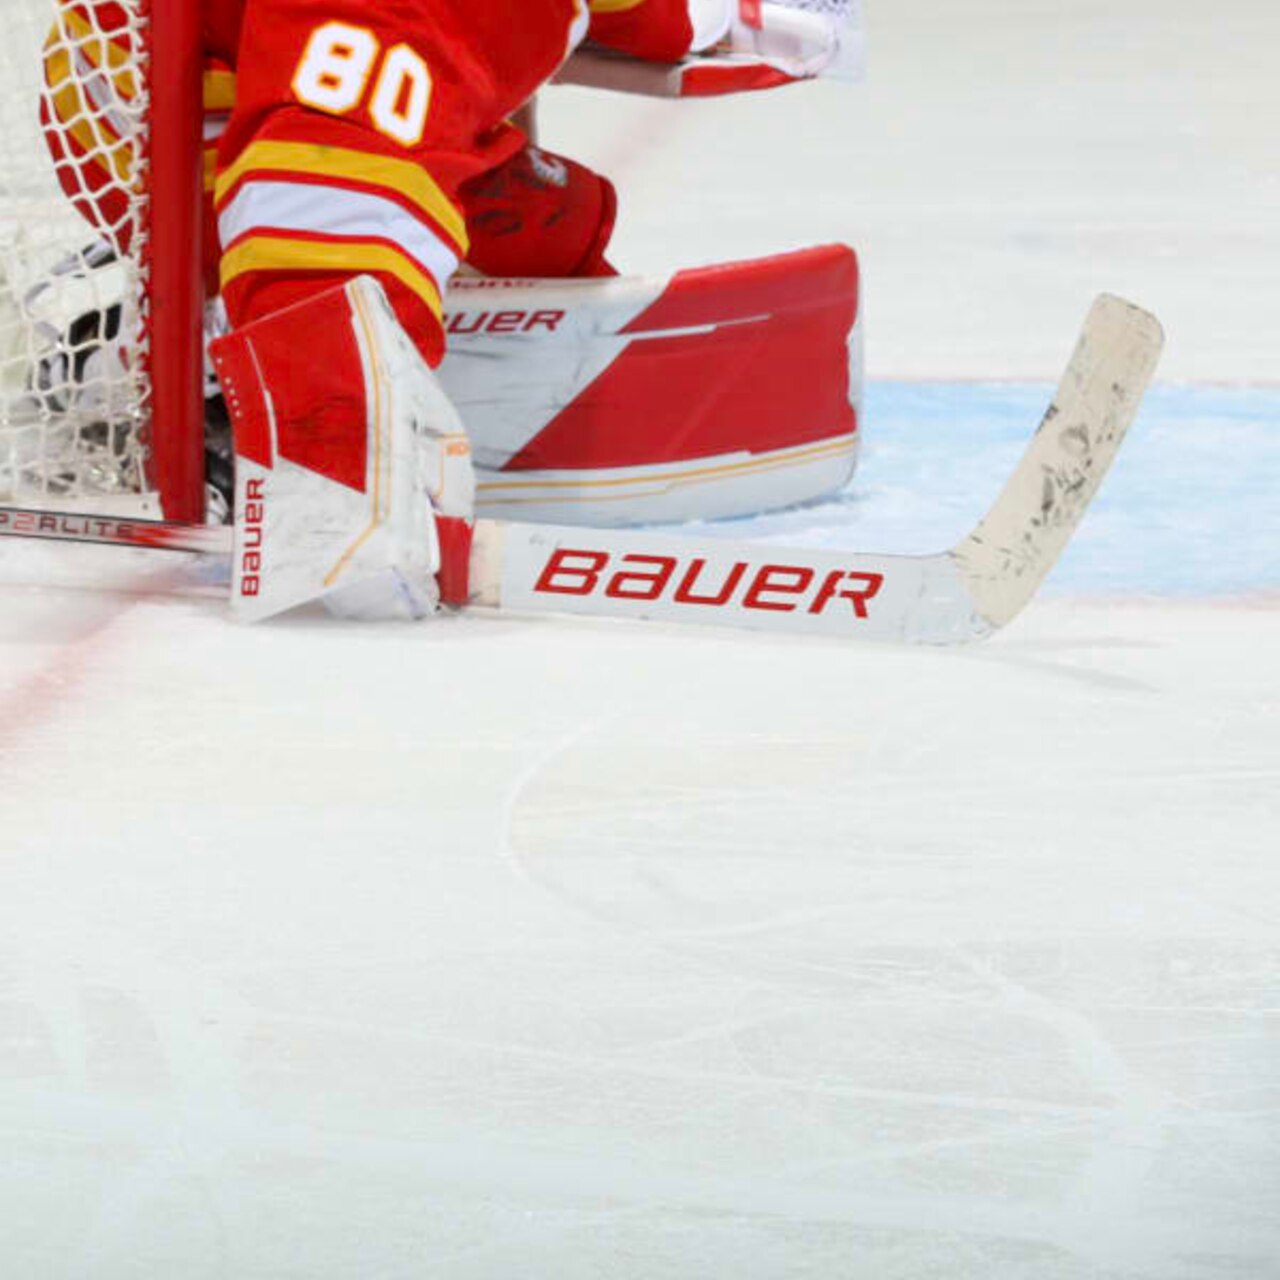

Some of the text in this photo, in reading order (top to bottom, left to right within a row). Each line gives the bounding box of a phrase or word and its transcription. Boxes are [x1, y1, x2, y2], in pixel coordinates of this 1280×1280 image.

[291, 19, 433, 149] 80
[443, 309, 566, 334] UER
[534, 548, 885, 618] BAUER
